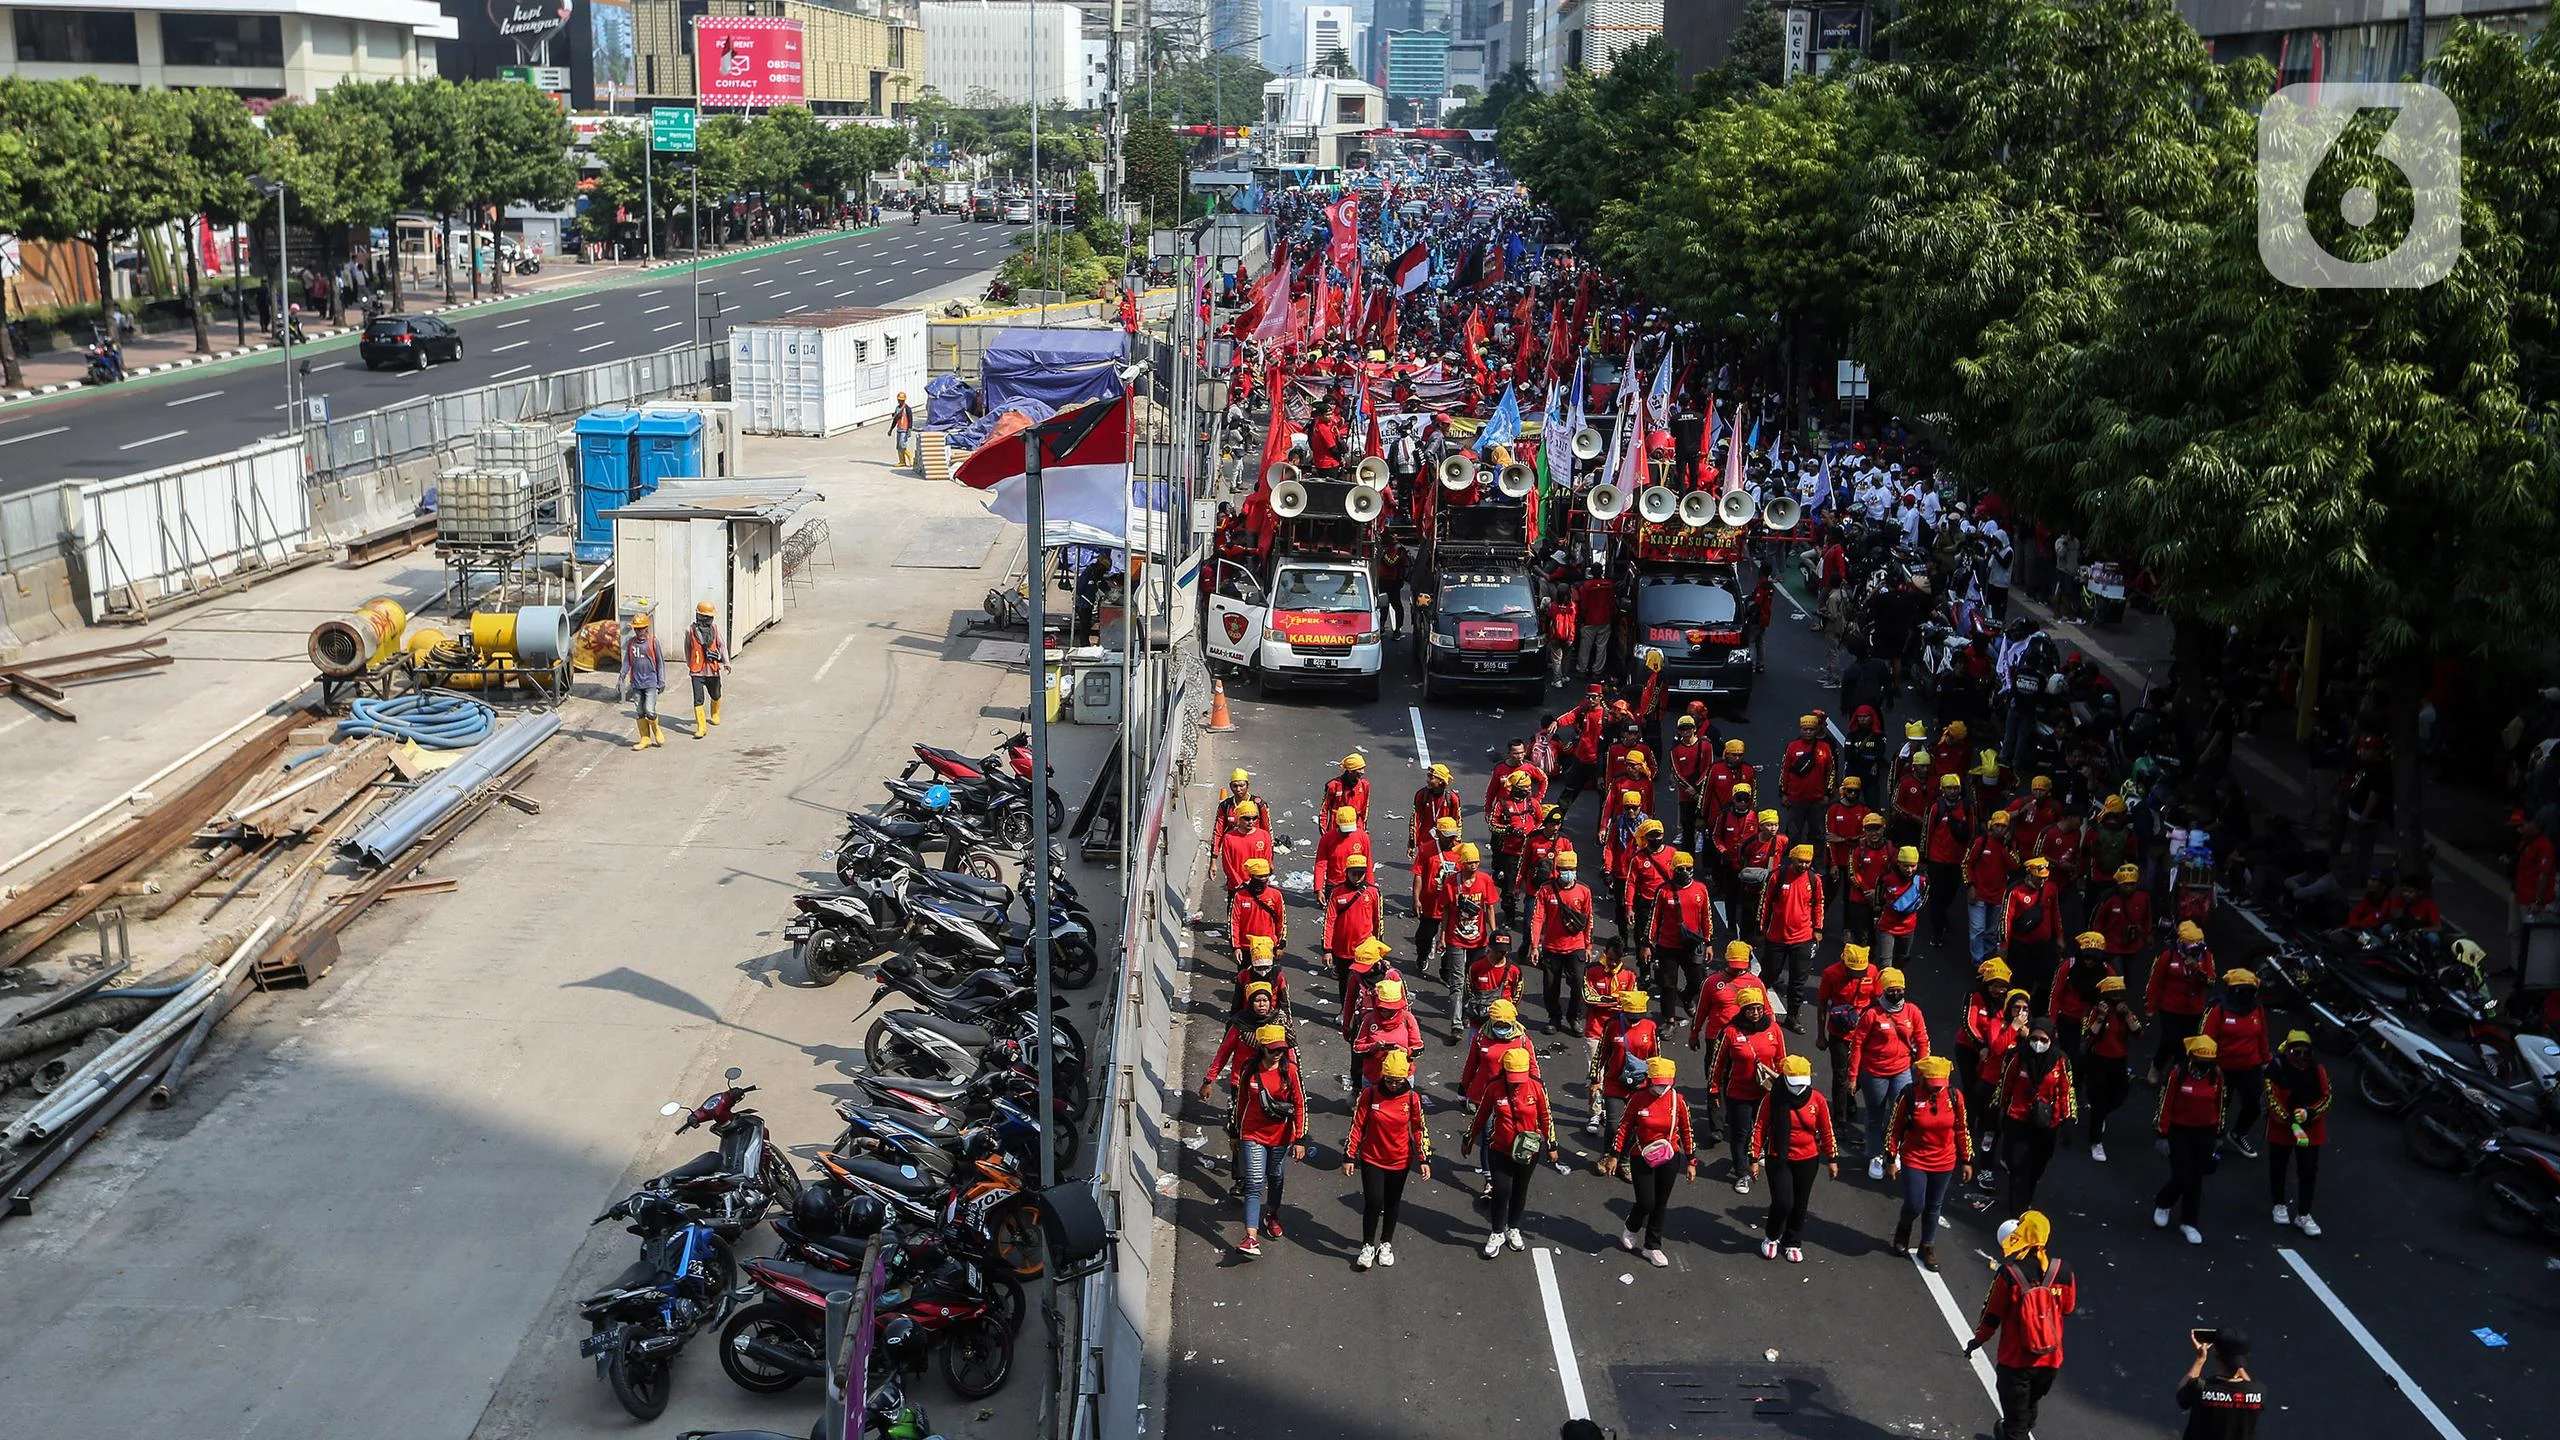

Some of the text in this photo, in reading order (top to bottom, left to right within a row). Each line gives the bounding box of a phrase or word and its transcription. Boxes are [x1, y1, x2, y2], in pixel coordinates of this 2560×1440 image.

[501, 17, 560, 35] kenangan
[733, 40, 754, 48] RENT
[715, 80, 757, 88] CONTACT
[315, 404, 321, 414] 8
[1201, 510, 1206, 519] 1
[1650, 535, 1732, 548] KASBI SUBANG
[1460, 575, 1511, 583] FSBN
[1290, 635, 1354, 644] KARAWANG
[1650, 628, 1741, 645] BARA KASBI
[1209, 646, 1223, 656] BARA
